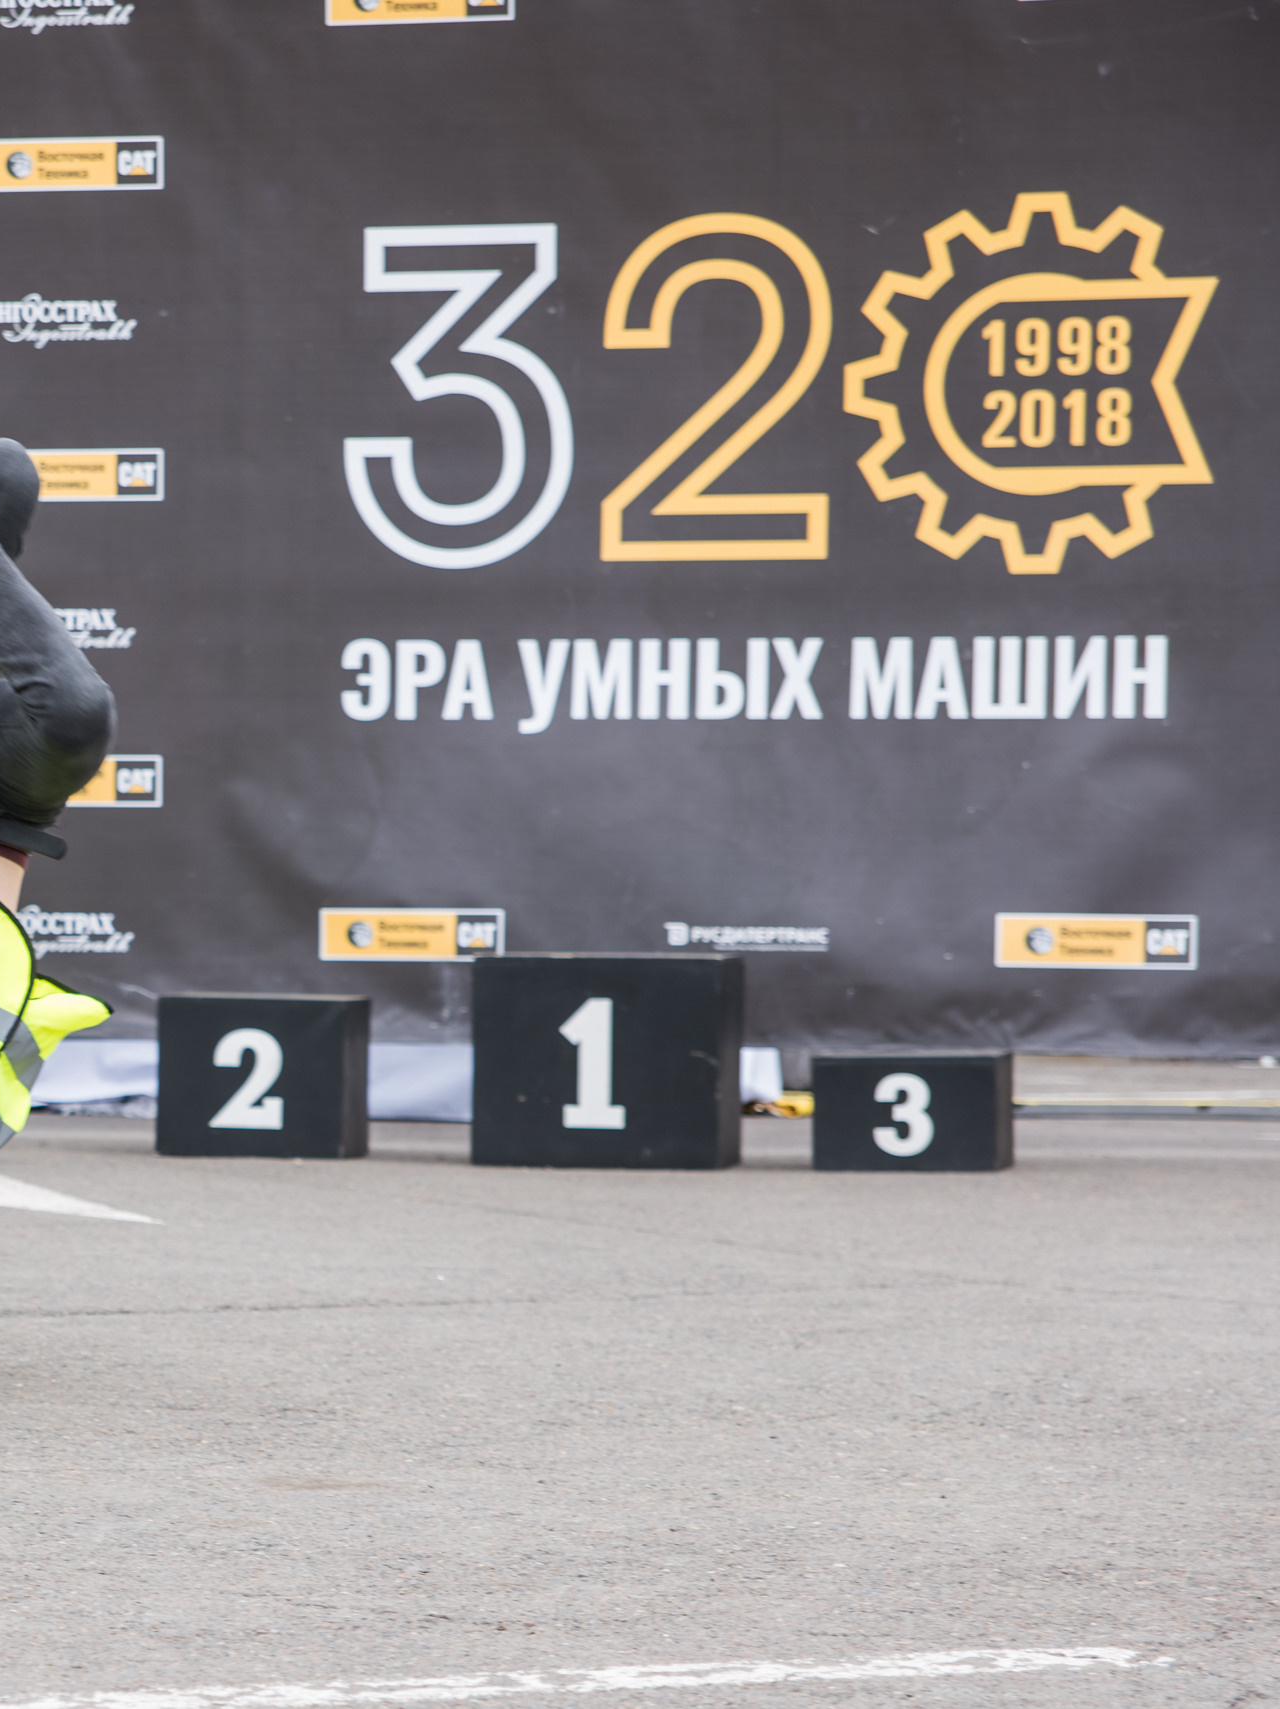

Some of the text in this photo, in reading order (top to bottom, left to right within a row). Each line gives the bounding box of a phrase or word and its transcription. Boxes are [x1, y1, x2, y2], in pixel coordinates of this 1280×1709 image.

[117, 150, 156, 176] CAT
[981, 315, 1132, 377] 1998
[981, 387, 1132, 448] 2018
[118, 462, 156, 487] CAT
[340, 634, 1169, 735] ЭРА УМНЫХ МАШИН
[117, 768, 155, 793] CAT
[16, 911, 116, 935] ОССТРАХ
[457, 921, 497, 948] CAT
[1146, 928, 1190, 955] CAT
[208, 1027, 284, 1131] 2
[558, 997, 627, 1130] 1
[872, 1073, 935, 1157] 3
